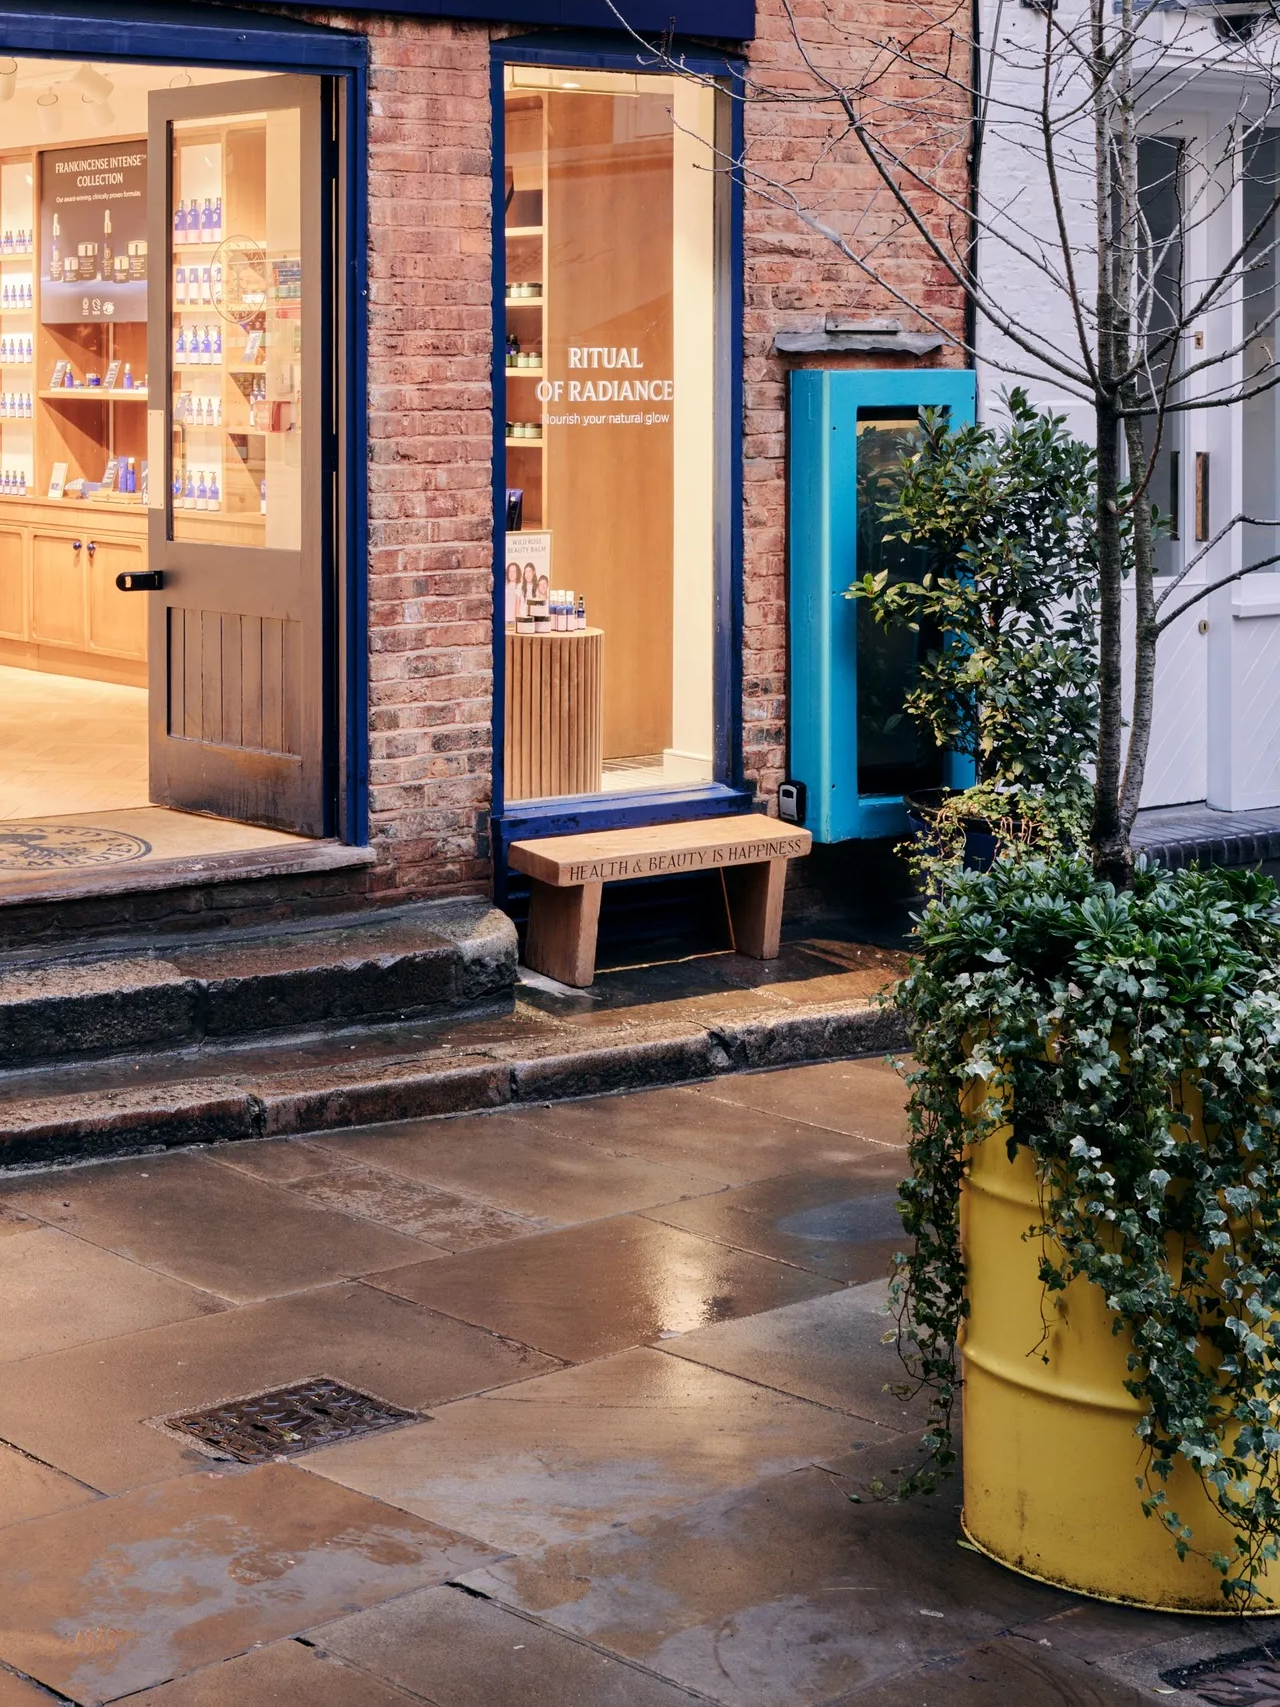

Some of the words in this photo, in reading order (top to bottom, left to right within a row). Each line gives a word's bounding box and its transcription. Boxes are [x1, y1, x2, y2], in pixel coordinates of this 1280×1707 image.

[55, 158, 109, 174] FRANKINCENSE
[76, 173, 123, 187] COLLECTION
[109, 192, 123, 200] proven
[568, 347, 644, 369] RITUAL
[535, 380, 564, 402] OF
[568, 380, 674, 402] RADIANCE
[541, 413, 581, 425] Nourish
[583, 415, 607, 426] your
[608, 412, 643, 424] natural
[645, 412, 670, 425] glow
[507, 546, 529, 554] BEAUTY
[2, 827, 103, 837] YARD
[570, 860, 628, 881] HEALTH
[632, 858, 643, 873] &
[649, 851, 708, 872] BEAUTY
[712, 848, 724, 862] IS
[728, 839, 802, 860] HAPPINESS
